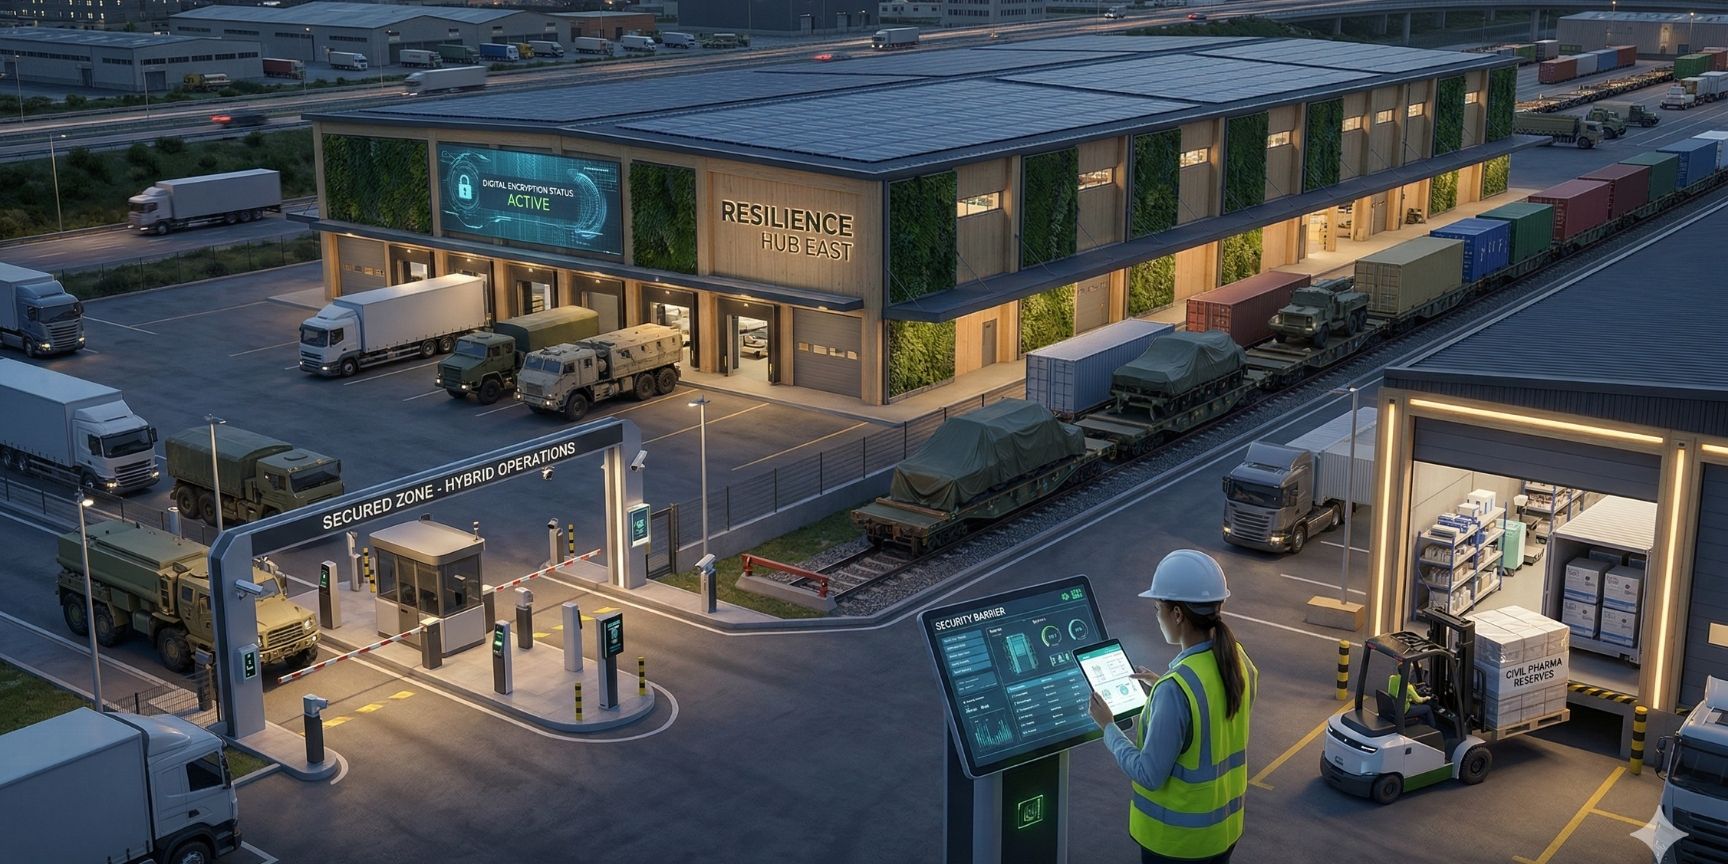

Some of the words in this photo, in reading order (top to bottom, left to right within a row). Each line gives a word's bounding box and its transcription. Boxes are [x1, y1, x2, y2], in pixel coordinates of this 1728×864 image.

[482, 179, 507, 190] DIGITAL
[507, 182, 549, 194] ENCRYPTION
[549, 187, 574, 197] STATUS
[507, 193, 551, 211] ACTIVE
[721, 200, 853, 237] RESILIENCE
[761, 232, 800, 253] HUB
[805, 237, 853, 261] EAST
[323, 497, 392, 530] SECURED
[396, 484, 434, 508] ZONE
[445, 467, 494, 493] HYBRID
[498, 441, 576, 476] OPERATIONS
[935, 614, 972, 631] SECURITY
[973, 607, 1006, 621] BARRIER
[1505, 668, 1527, 679] CIVIL
[1528, 657, 1562, 673] PHARMA
[1513, 670, 1554, 687] RESERVES
